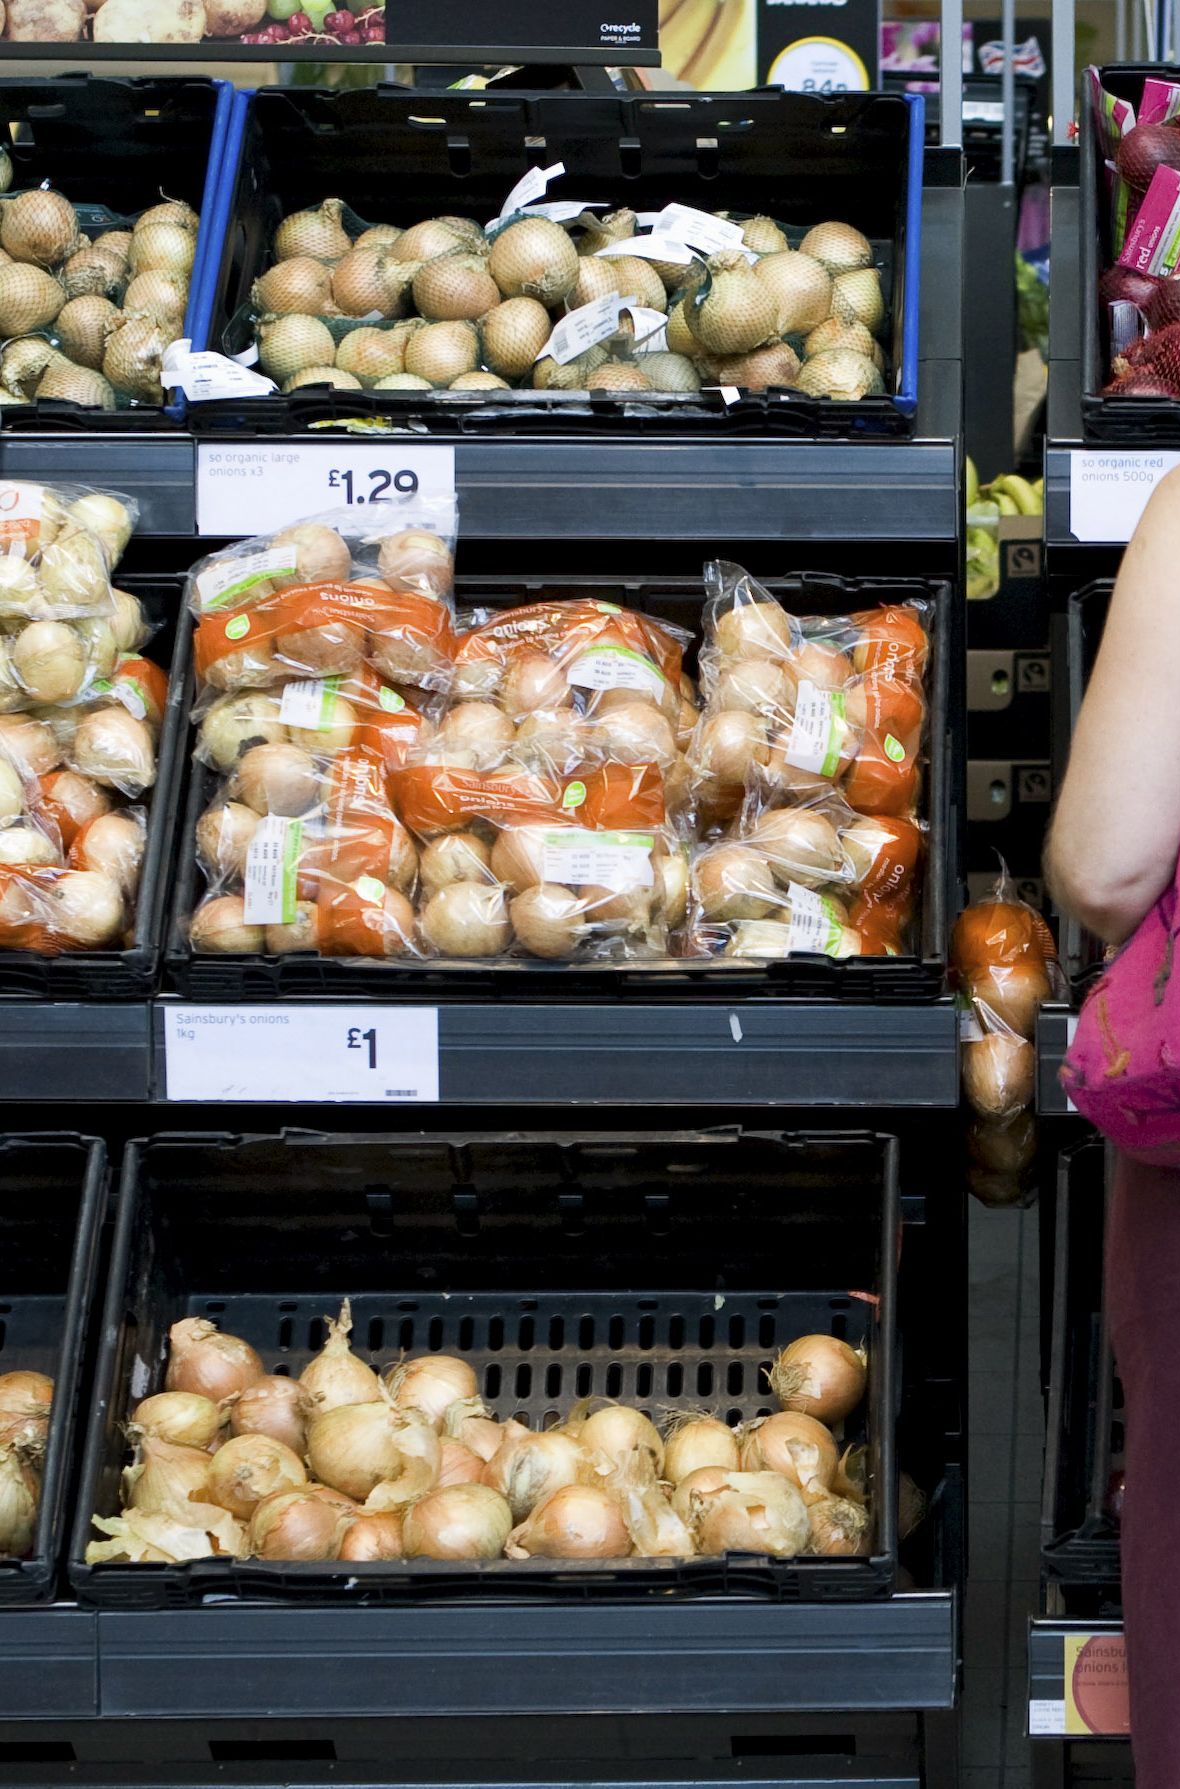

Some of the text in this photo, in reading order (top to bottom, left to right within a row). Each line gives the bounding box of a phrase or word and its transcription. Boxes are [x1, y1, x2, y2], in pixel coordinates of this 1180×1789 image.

[609, 22, 641, 34] recycle
[1136, 247, 1151, 270] red
[209, 451, 300, 465] so organic large
[1082, 457, 1164, 470] so organic red
[209, 466, 263, 477] onions x3
[1082, 471, 1154, 483] onions 500g
[328, 468, 419, 505] £1.29
[319, 592, 376, 605] onions
[176, 1013, 290, 1027] Sainsbury's onions
[177, 1028, 195, 1040] 1kg
[347, 1027, 377, 1069] £1
[1076, 1662, 1119, 1672] onions
